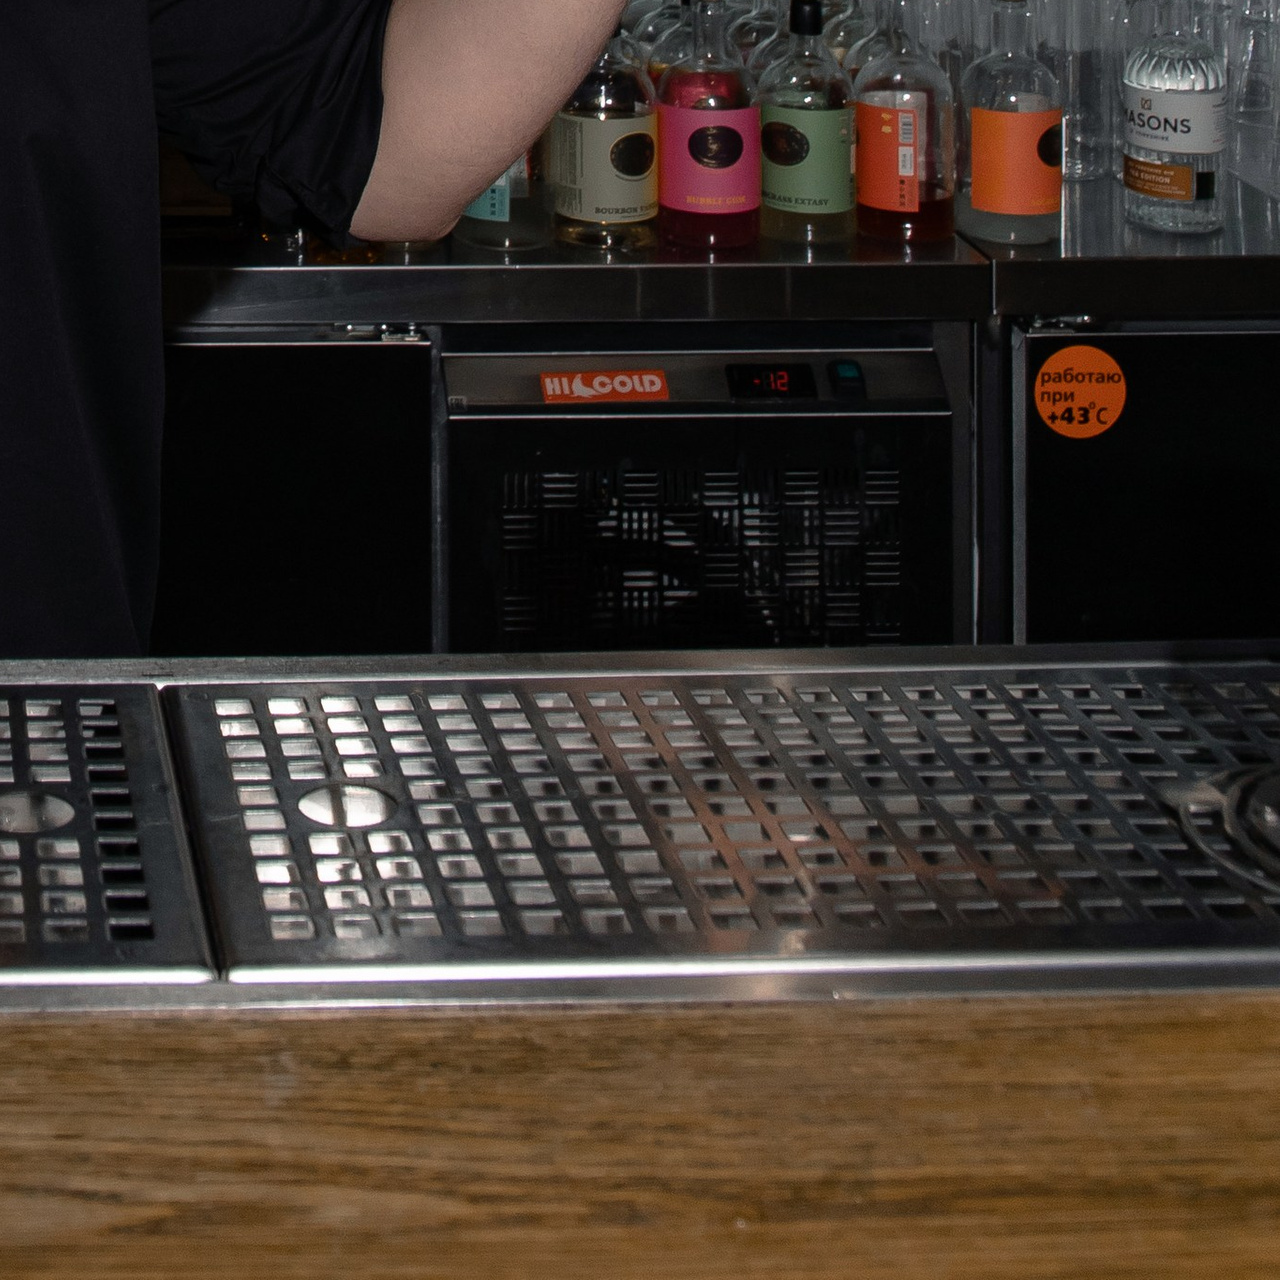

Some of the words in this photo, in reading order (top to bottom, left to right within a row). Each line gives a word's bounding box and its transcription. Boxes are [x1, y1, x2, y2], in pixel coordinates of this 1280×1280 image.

[1140, 172, 1171, 184] EDITION
[794, 198, 829, 207] EXTASY
[593, 374, 662, 393] COLD
[1041, 367, 1122, 387] работаю
[1040, 391, 1075, 406] при
